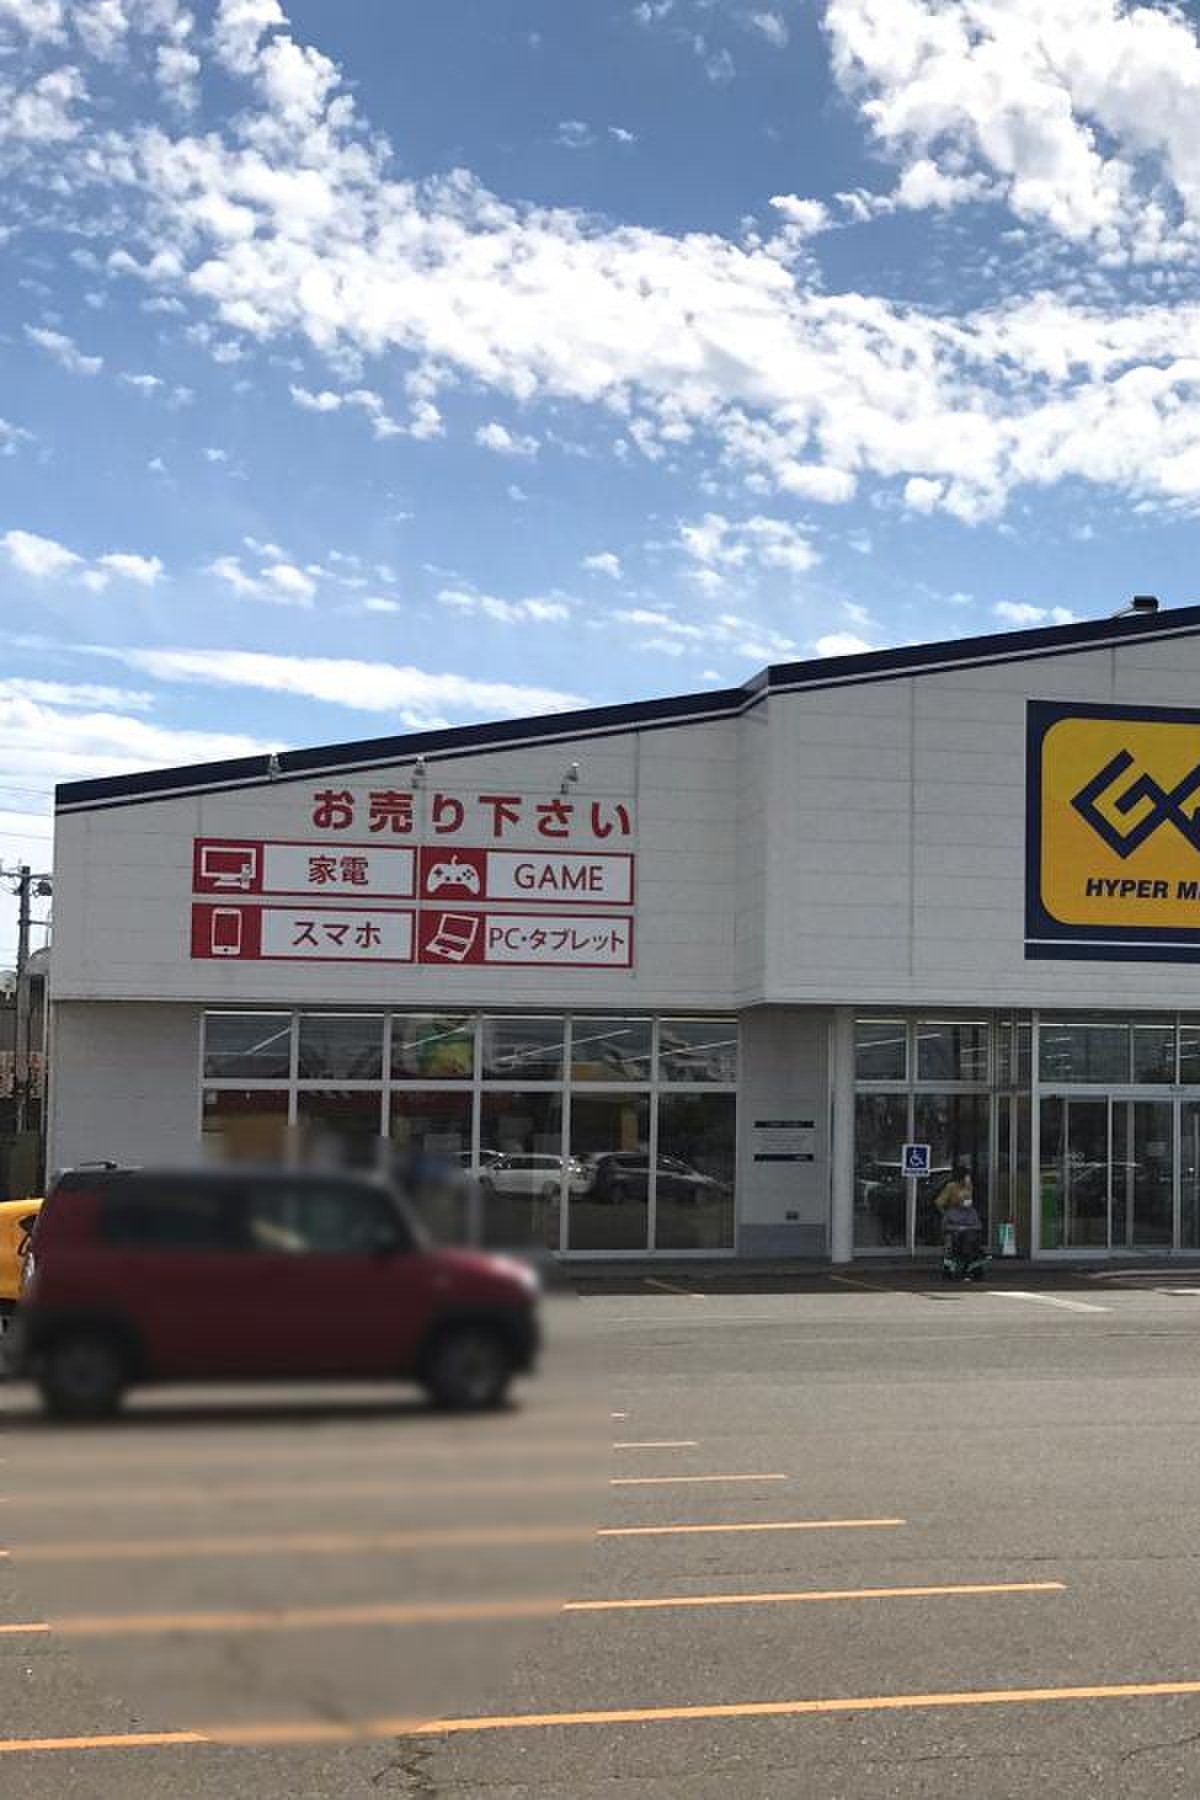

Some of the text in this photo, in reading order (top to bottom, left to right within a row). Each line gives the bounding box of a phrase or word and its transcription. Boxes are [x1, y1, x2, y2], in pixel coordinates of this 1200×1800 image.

[312, 789, 632, 839] お売り下さい
[308, 855, 369, 886] 家電
[514, 863, 604, 892] GAME
[1085, 878, 1169, 898] HYPER
[292, 921, 381, 947] スマホ
